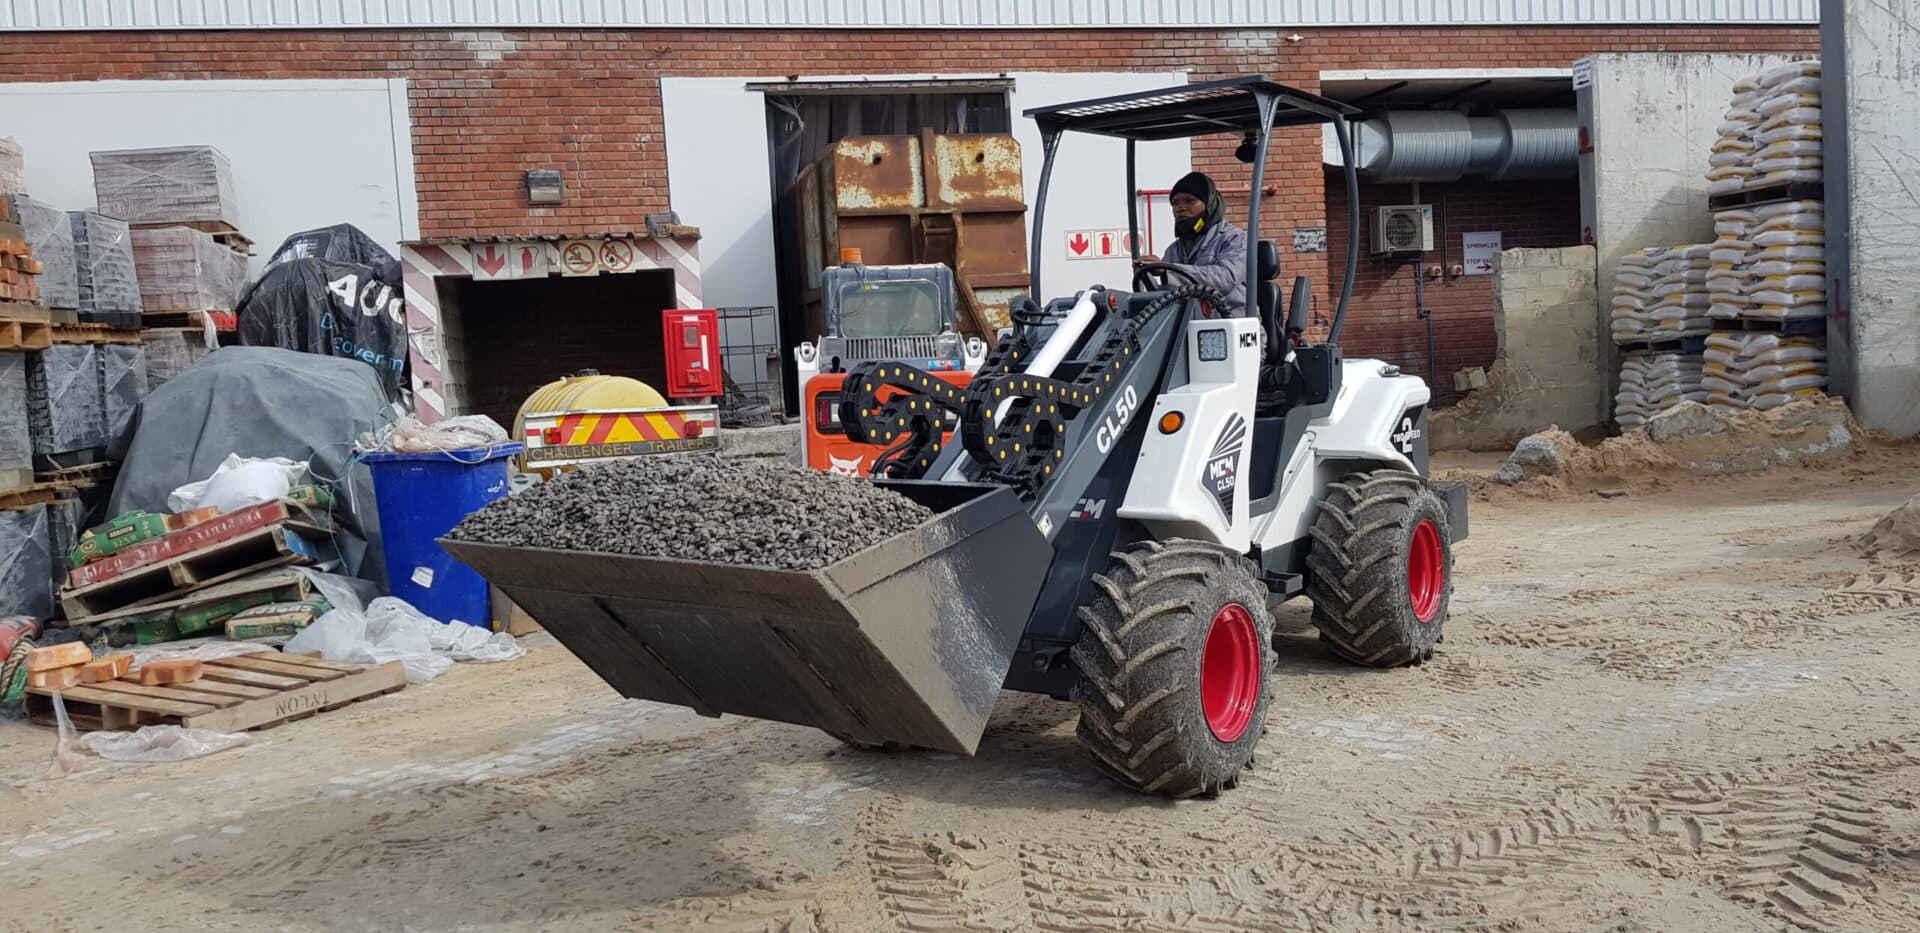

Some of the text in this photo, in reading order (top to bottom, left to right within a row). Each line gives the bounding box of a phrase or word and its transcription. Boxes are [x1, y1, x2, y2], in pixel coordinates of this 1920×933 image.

[1239, 332, 1257, 348] MCM
[1096, 384, 1137, 454] CL50
[531, 436, 714, 461] CHALLENGER TRAILERS
[1210, 455, 1234, 480] MCM
[1217, 475, 1235, 491] CL50
[275, 689, 330, 717] TYLON
